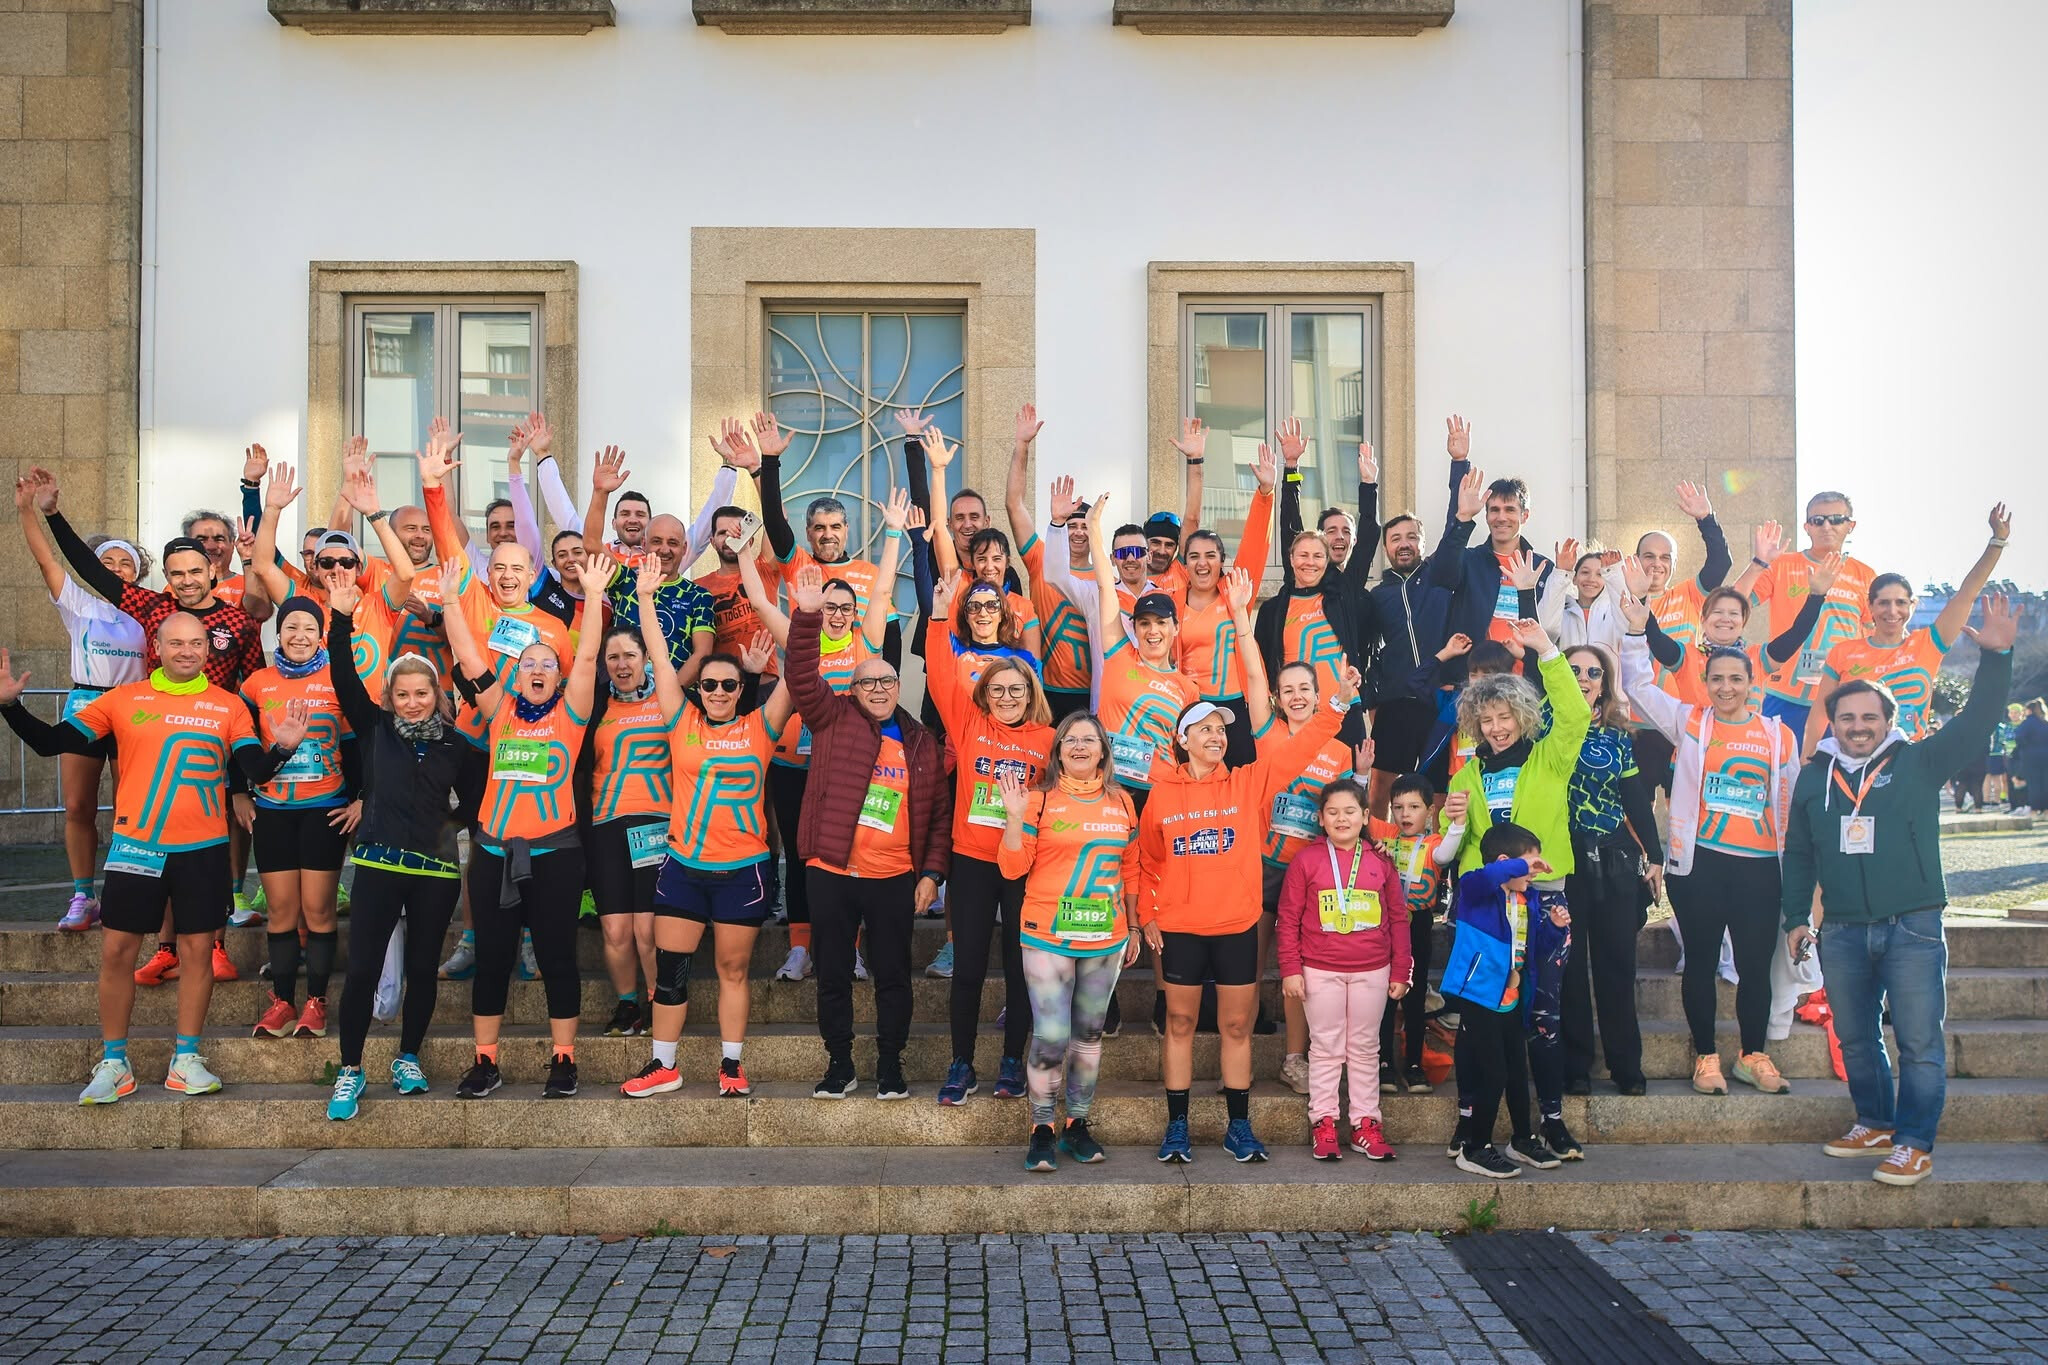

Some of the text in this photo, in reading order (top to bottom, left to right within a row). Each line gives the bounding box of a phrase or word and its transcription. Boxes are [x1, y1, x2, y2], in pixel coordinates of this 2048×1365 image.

[91, 640, 111, 648] Clube
[165, 714, 220, 731] CORDEX
[706, 738, 751, 750] CORDEX
[1726, 741, 1771, 757] CORDEX
[506, 751, 539, 762] 3197
[1112, 745, 1143, 760] 2374
[1726, 787, 1752, 799] 991
[1162, 811, 1200, 826] RUNNNG
[1287, 806, 1319, 823] 2376
[1074, 910, 1108, 922] 3192
